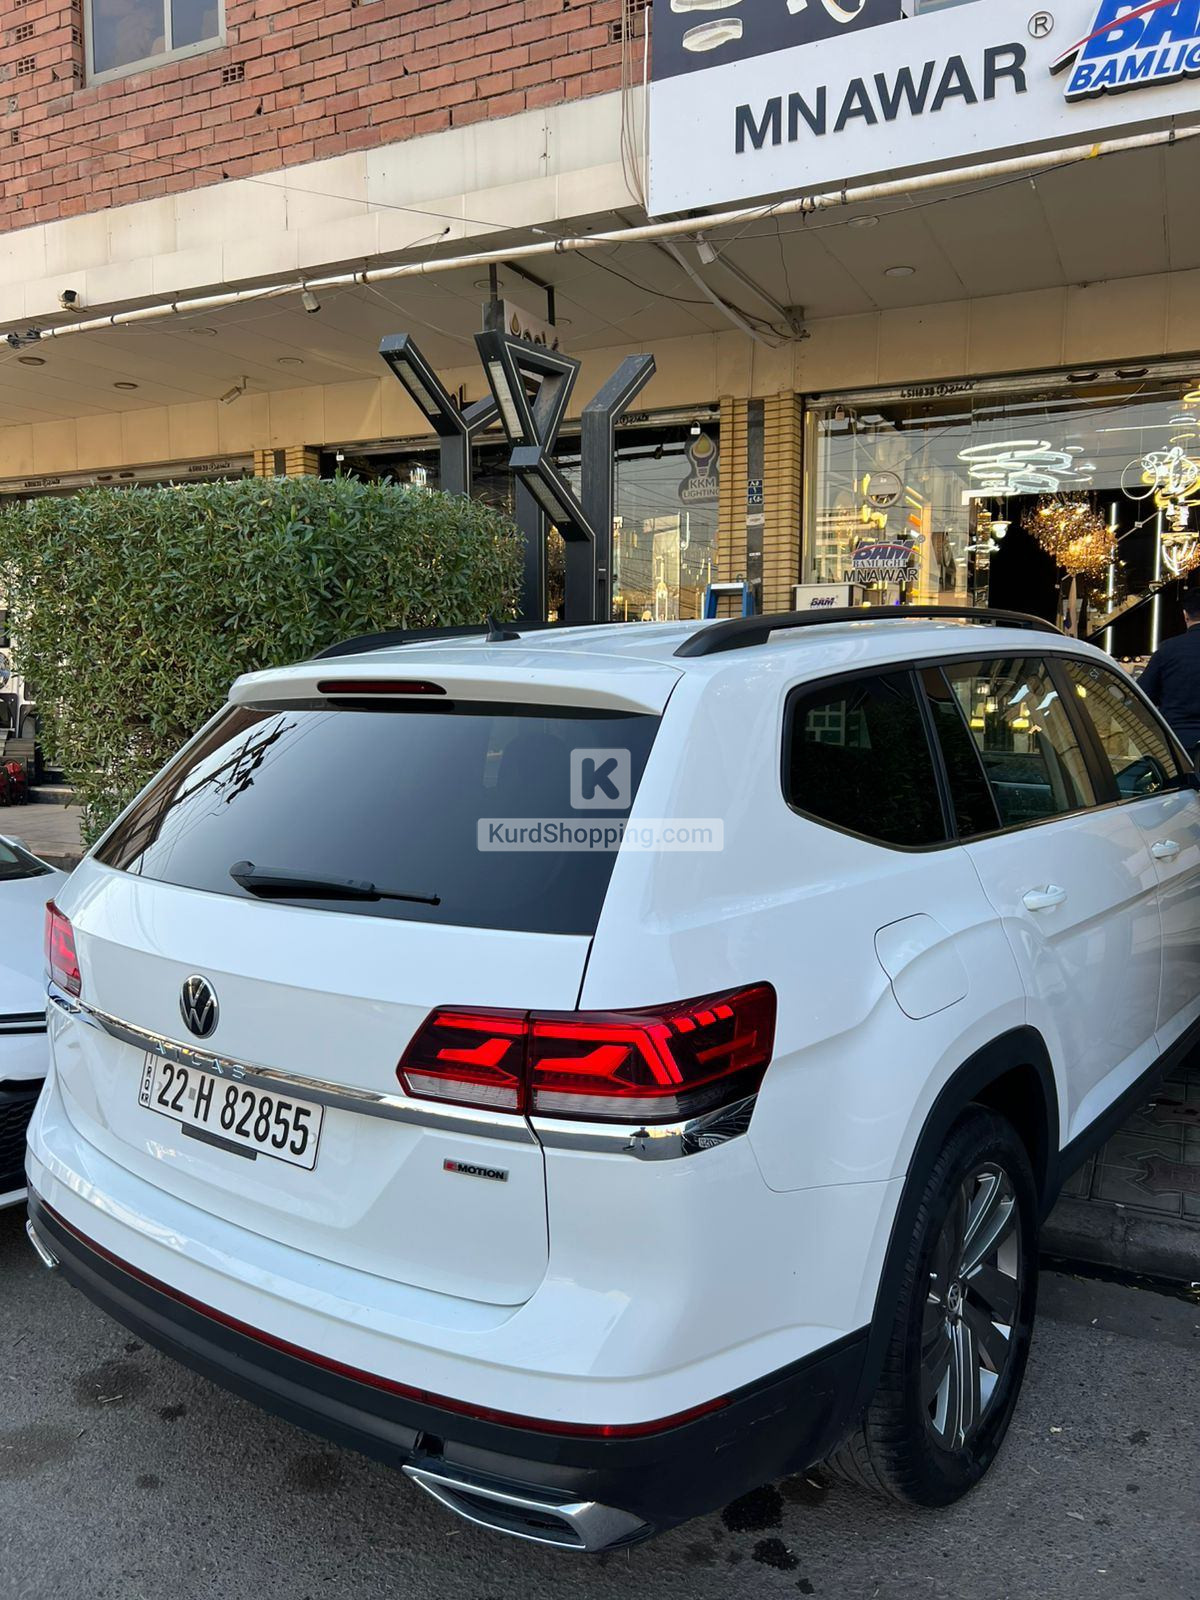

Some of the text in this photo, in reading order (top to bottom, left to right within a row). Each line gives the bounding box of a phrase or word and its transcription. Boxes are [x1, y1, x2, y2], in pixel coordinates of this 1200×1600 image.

[735, 42, 1027, 154] MNAWAR
[690, 478, 715, 489] KKM
[843, 568, 918, 582] MNAWAR
[155, 1040, 246, 1080] ATLAS
[157, 1063, 312, 1156] 22 H 82855
